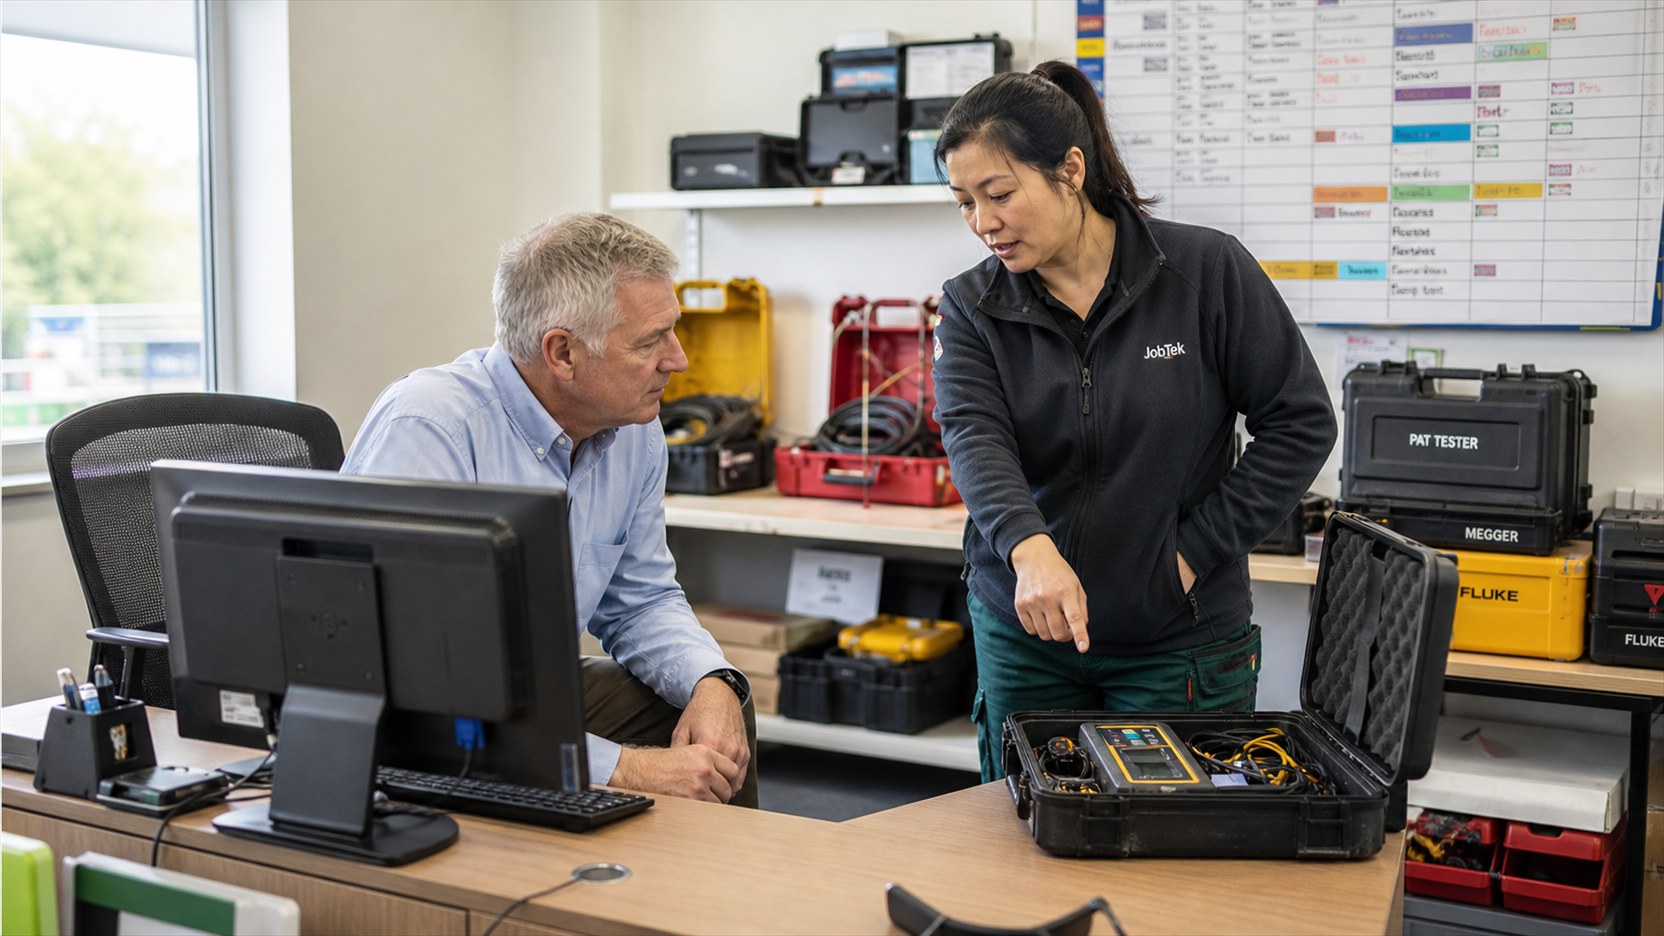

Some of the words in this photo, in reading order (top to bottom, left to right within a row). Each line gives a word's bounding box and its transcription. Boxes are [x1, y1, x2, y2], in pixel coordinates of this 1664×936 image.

[1144, 341, 1186, 359] JobTek
[1409, 433, 1432, 447] PAT
[1433, 434, 1479, 450] TESTER
[1465, 526, 1519, 543] MEGGER
[1460, 586, 1519, 602] FLUKE
[1624, 633, 1664, 648] FLUKE
